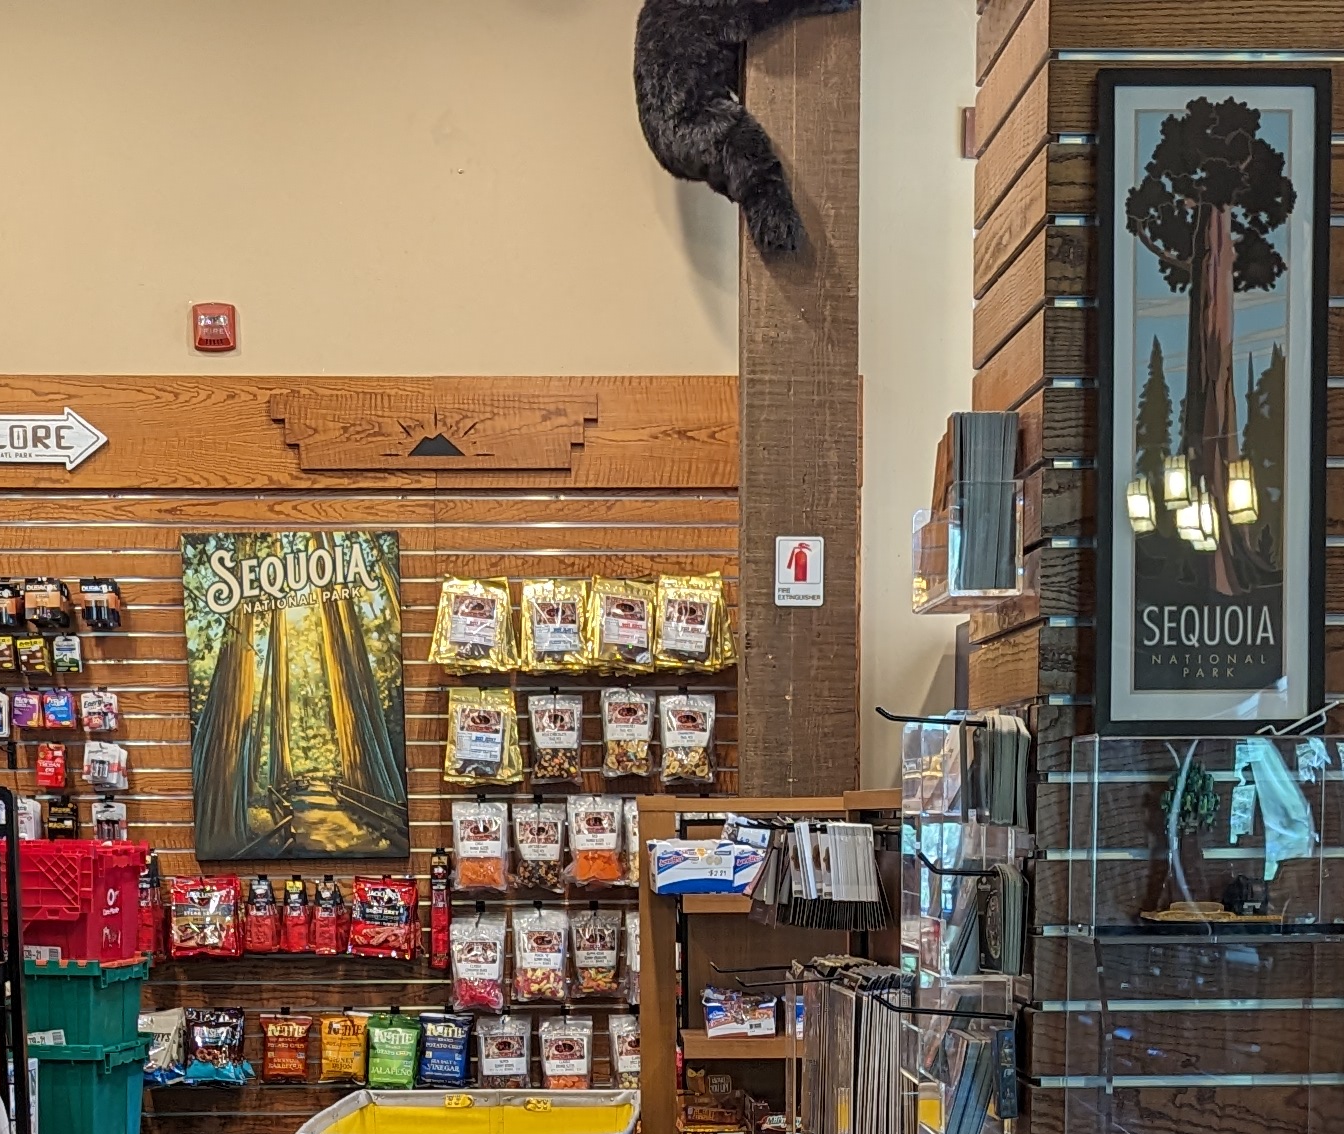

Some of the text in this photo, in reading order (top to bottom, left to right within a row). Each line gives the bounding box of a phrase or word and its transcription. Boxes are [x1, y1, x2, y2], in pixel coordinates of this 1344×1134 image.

[206, 543, 380, 614] SEQUOIA
[242, 586, 363, 615] NATIONAL PARK
[1142, 605, 1275, 648] SEQUOIA
[1151, 654, 1266, 665] NATIONAL
[1182, 667, 1234, 678] PARK
[427, 1063, 460, 1072] VINEGAR
